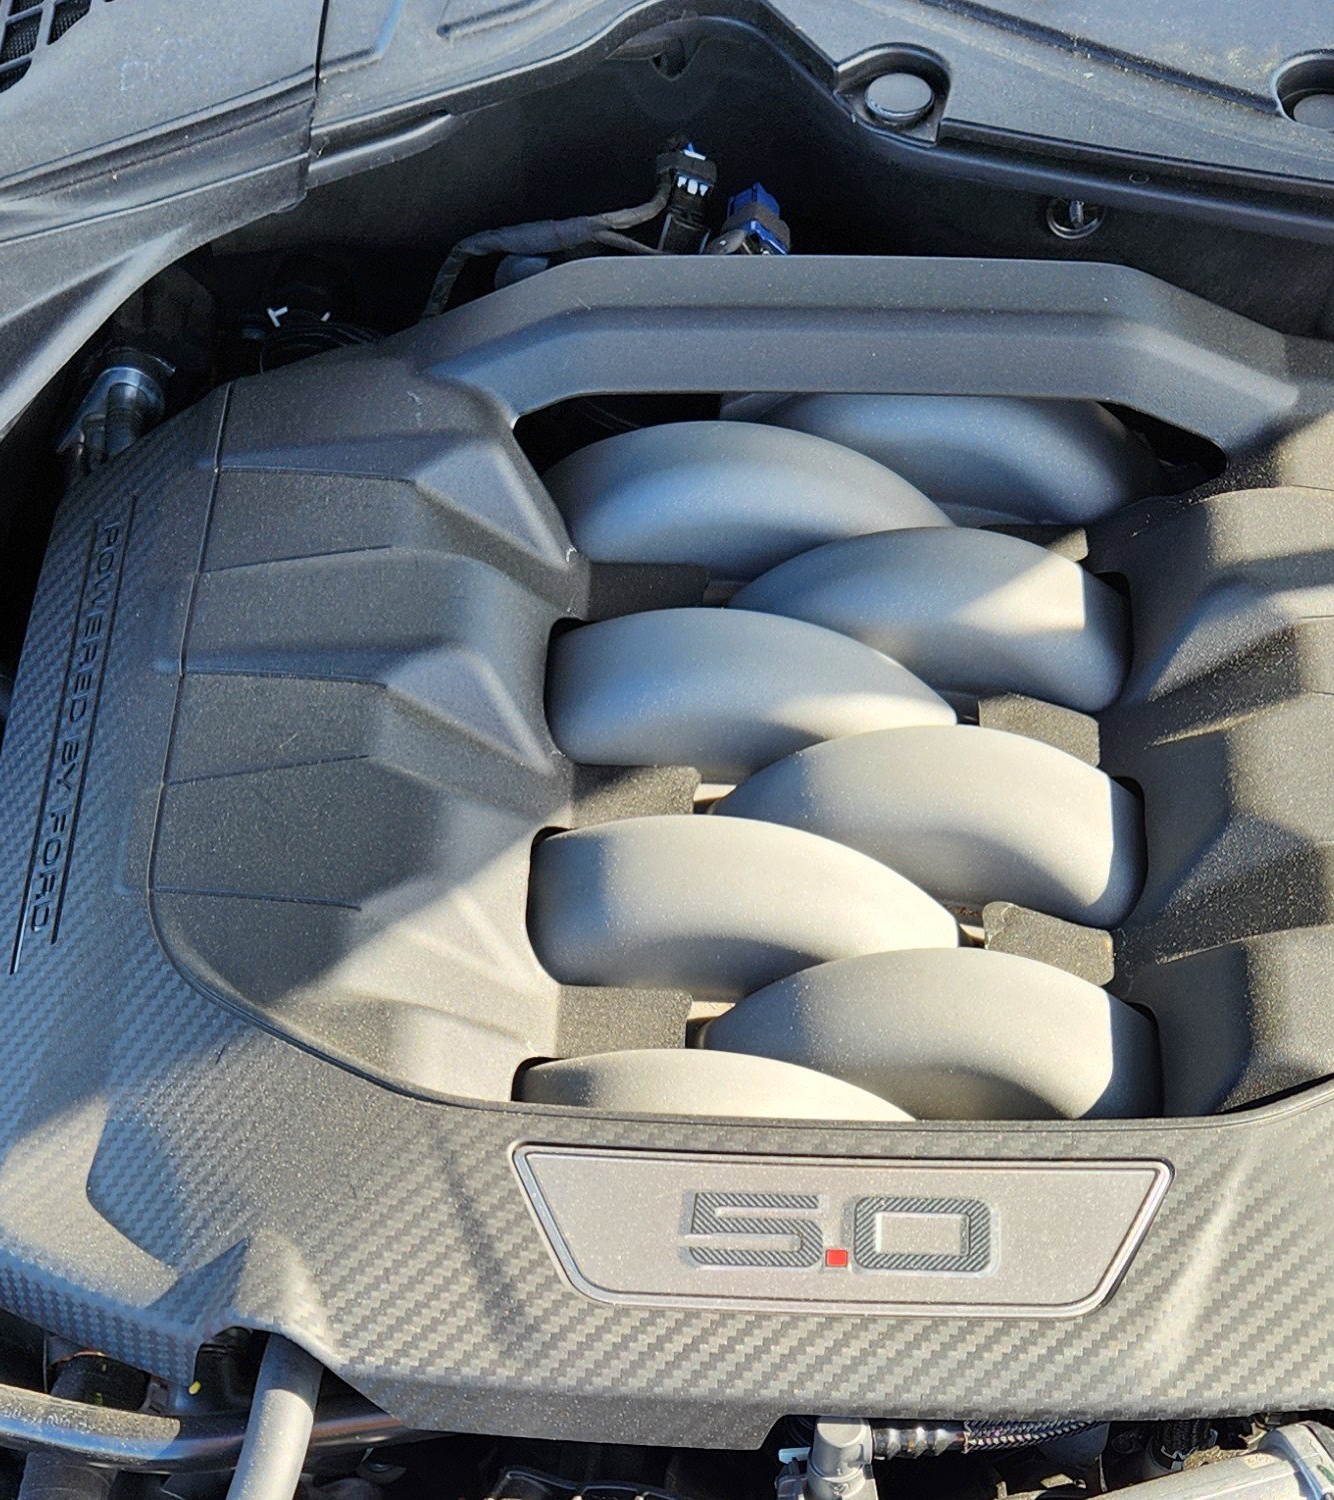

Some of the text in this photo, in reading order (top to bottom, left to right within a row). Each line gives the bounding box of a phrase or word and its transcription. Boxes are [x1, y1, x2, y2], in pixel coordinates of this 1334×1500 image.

[31, 520, 123, 933] POWERED BY FORD
[681, 1191, 997, 1274] 5.0
